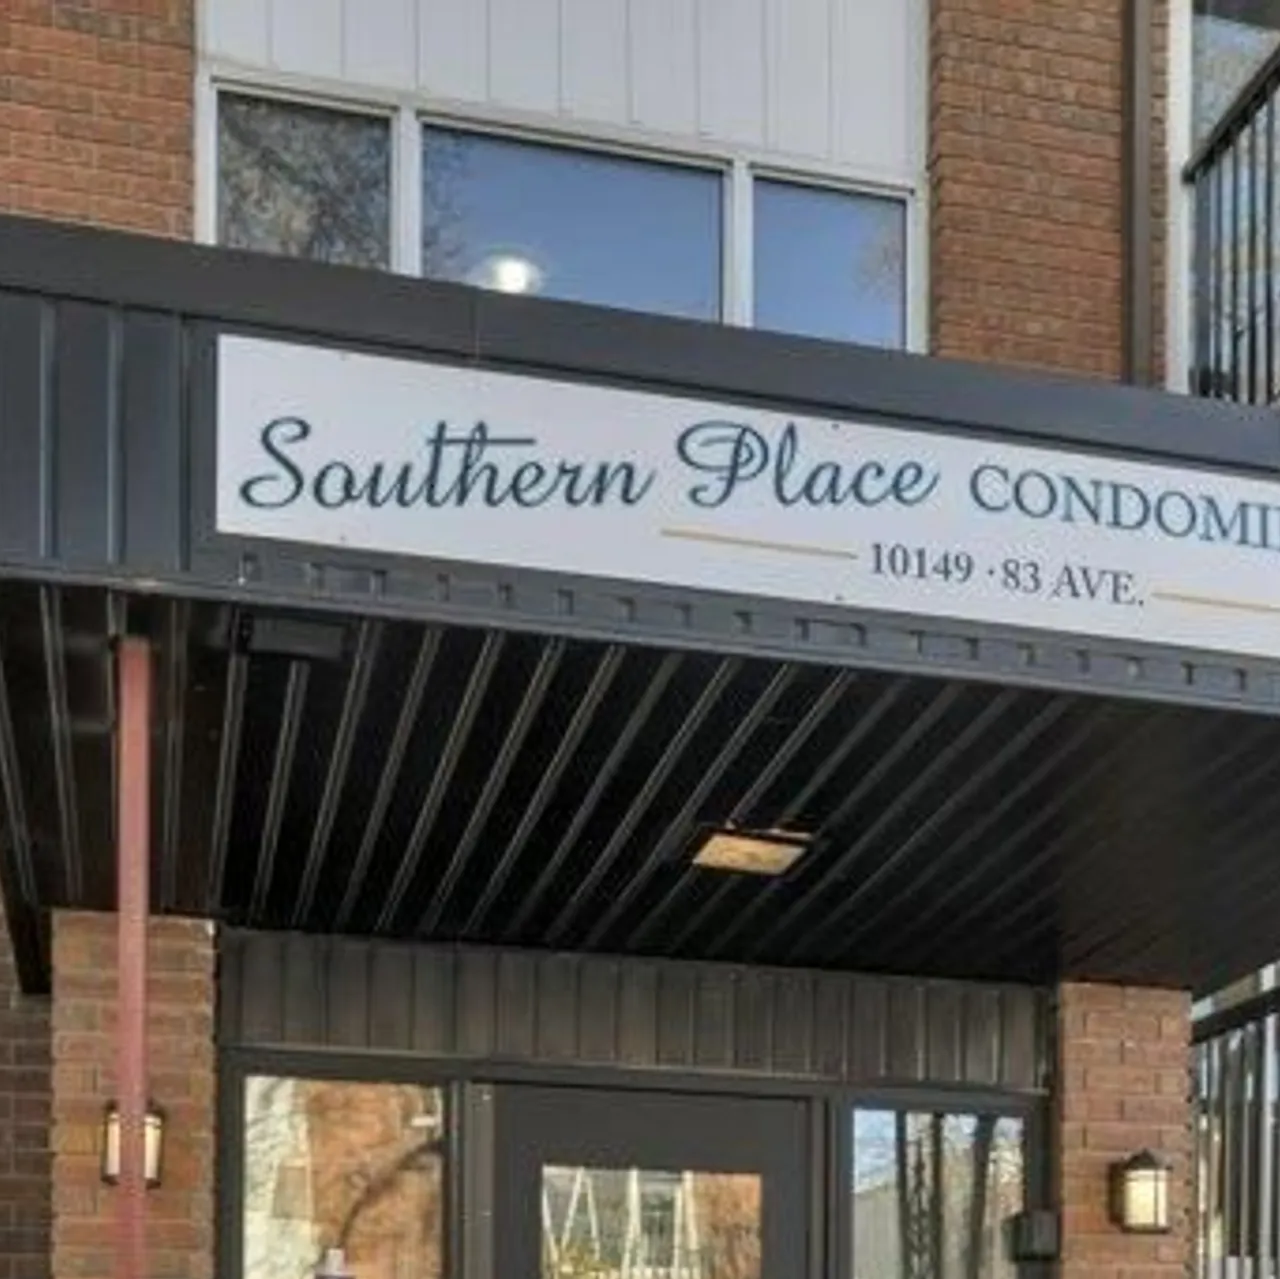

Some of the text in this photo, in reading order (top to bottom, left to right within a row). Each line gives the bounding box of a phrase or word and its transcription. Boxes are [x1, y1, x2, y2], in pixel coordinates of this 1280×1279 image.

[239, 416, 654, 510] Southern
[676, 420, 939, 508] Place
[870, 542, 974, 584] 10149
[1050, 565, 1145, 608] AVE.
